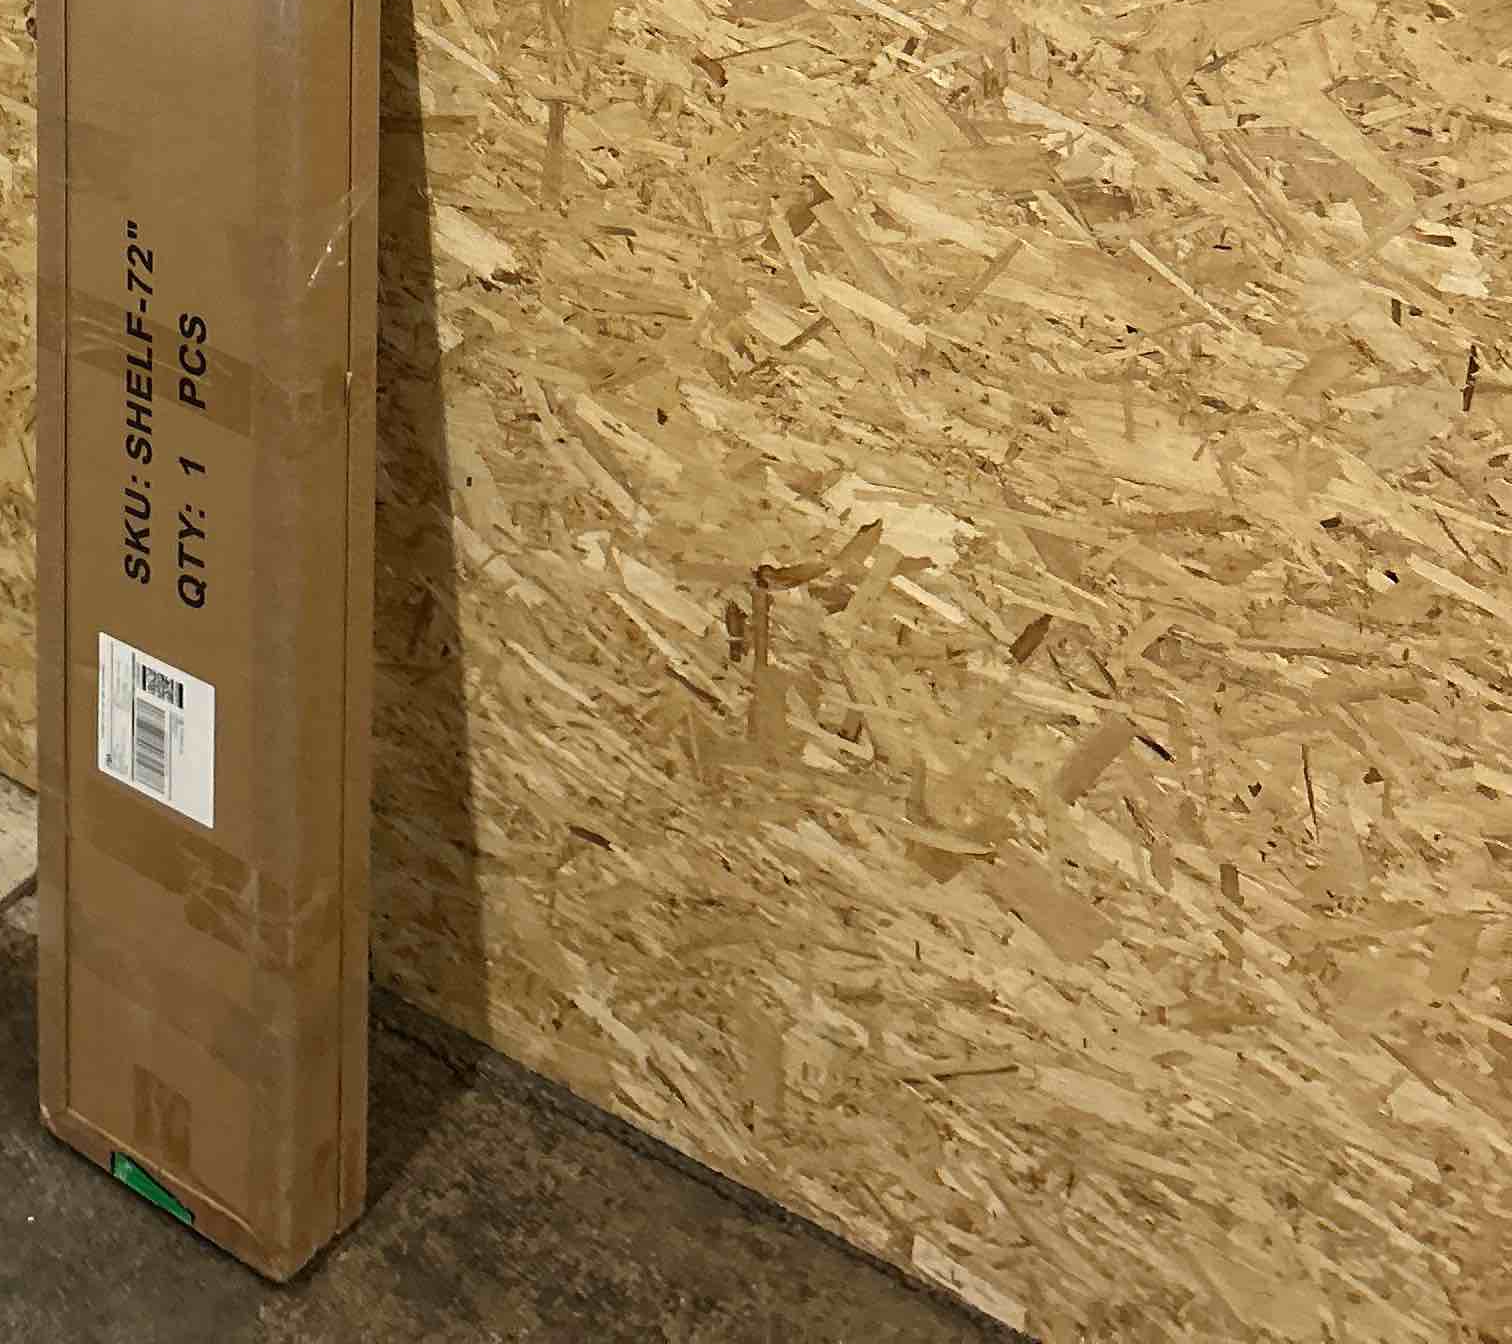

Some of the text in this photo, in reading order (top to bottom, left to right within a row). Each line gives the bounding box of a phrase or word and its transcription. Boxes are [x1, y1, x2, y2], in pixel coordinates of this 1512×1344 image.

[124, 219, 154, 585] SKU: SHELF-72"
[178, 312, 208, 609] QTY: 1 PCS
